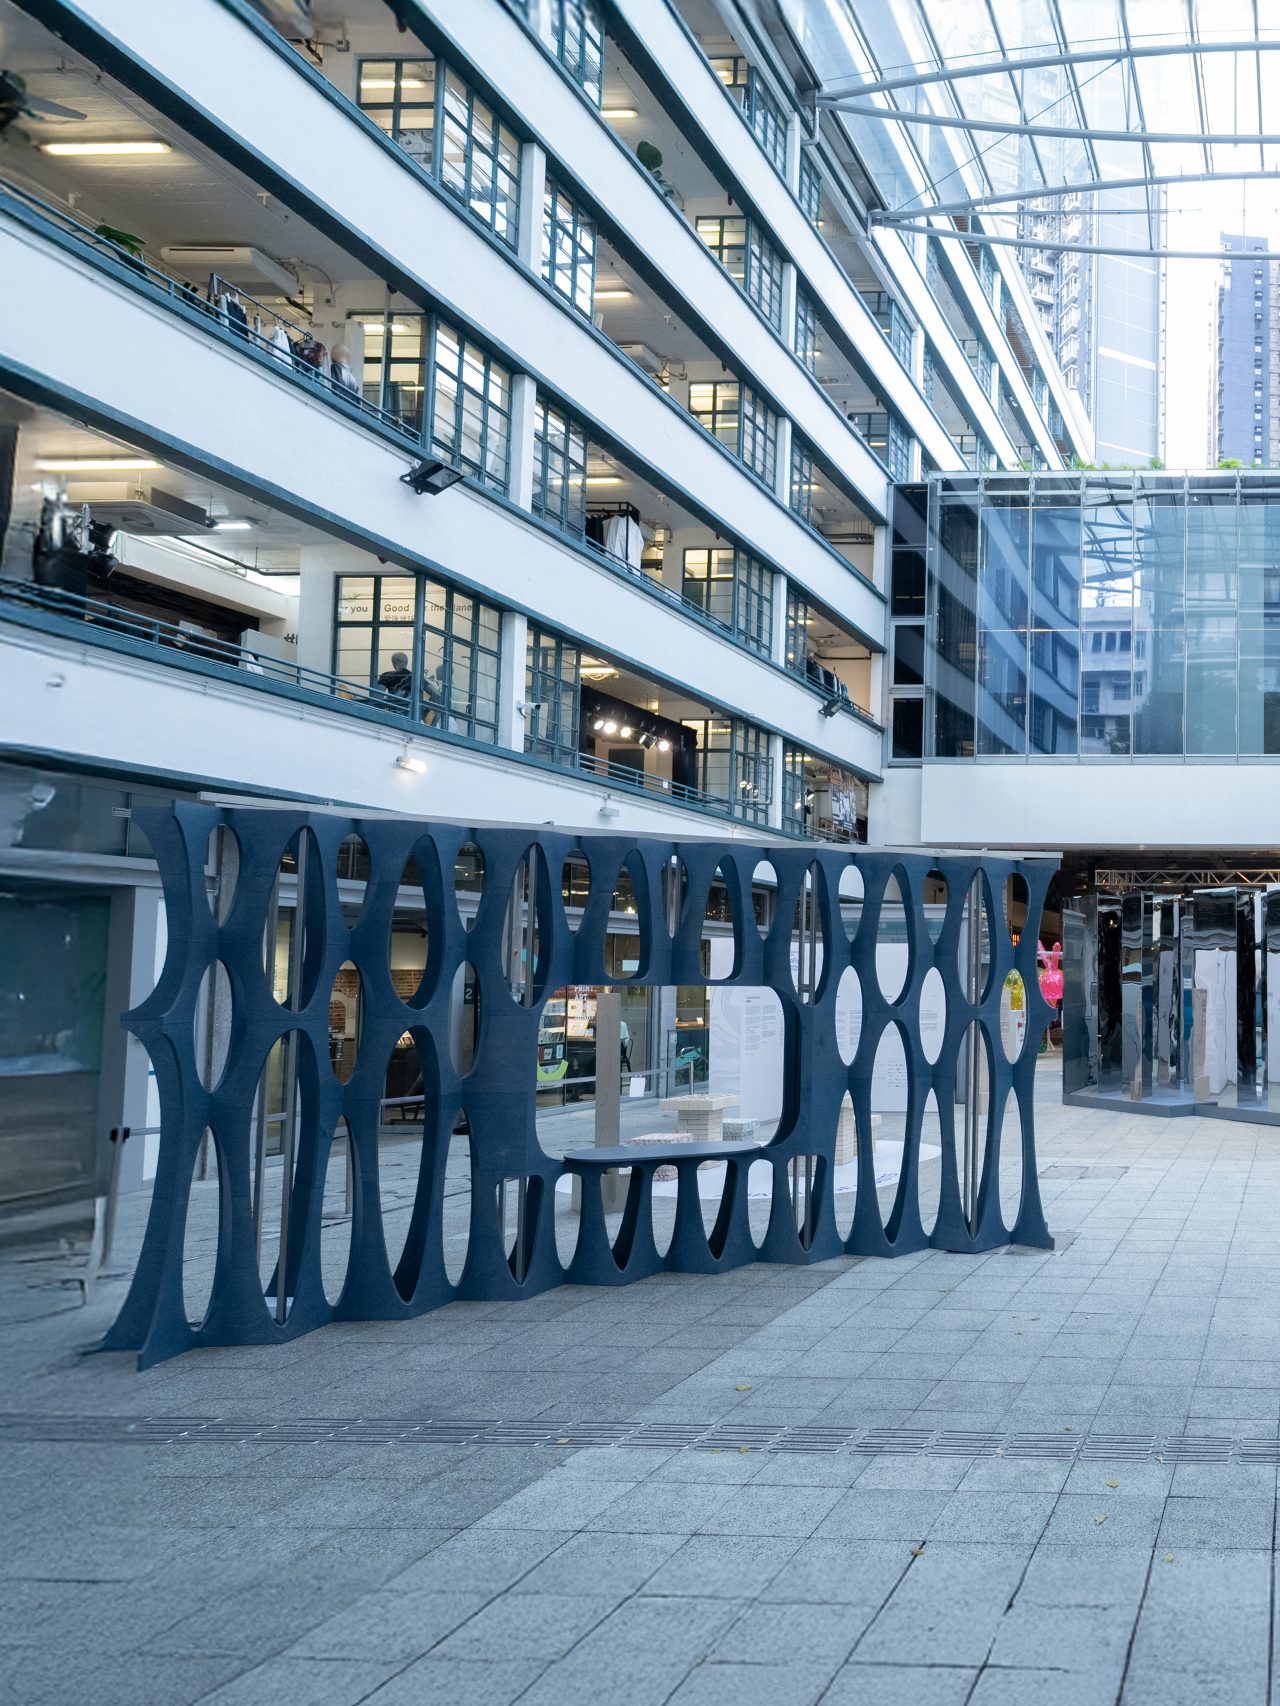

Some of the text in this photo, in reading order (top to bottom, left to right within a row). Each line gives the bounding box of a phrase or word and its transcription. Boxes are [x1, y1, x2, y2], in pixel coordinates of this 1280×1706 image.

[351, 606, 368, 616] you
[384, 604, 410, 612] Good
[465, 987, 473, 1000] 2
